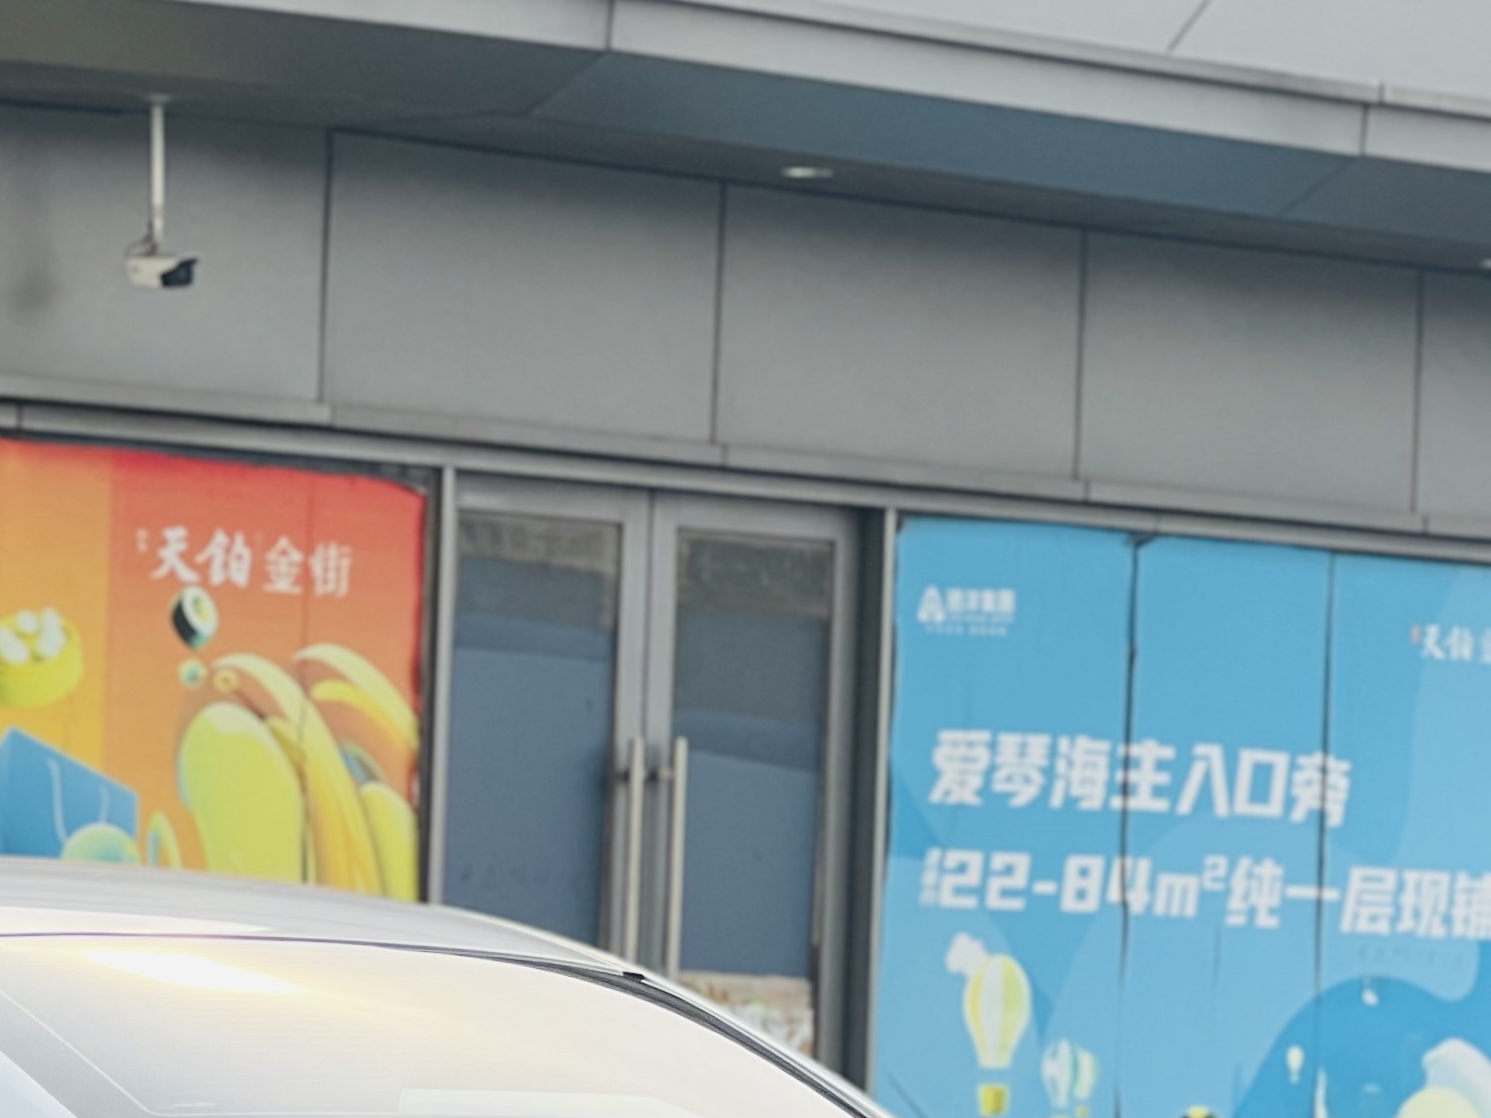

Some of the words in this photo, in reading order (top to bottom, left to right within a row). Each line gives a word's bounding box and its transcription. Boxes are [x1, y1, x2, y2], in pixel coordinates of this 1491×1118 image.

[928, 729, 1352, 828] 爱琴海主入口旁
